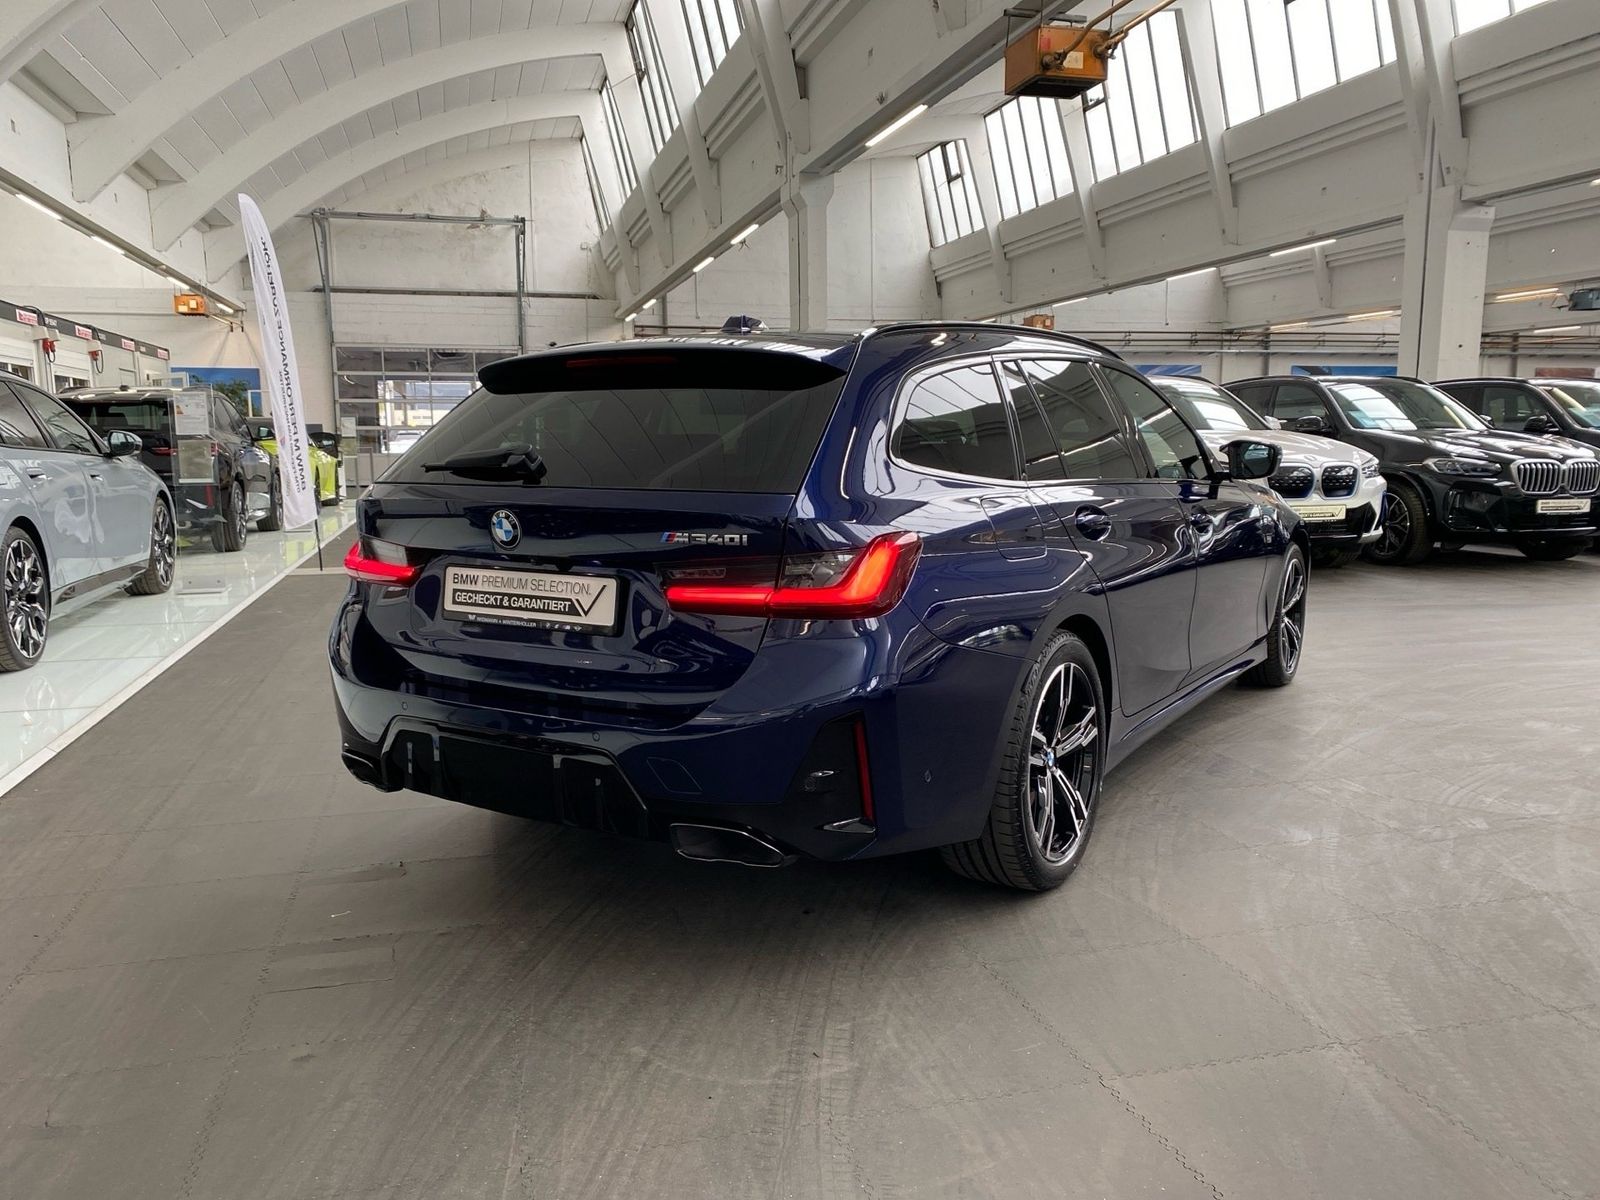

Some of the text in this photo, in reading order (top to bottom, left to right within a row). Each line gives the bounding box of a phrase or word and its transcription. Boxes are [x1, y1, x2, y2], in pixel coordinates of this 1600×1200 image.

[453, 573, 591, 596] BMW PREMIUM SELECTION.
[455, 591, 571, 612] GECHECKT & GARANTIERT
